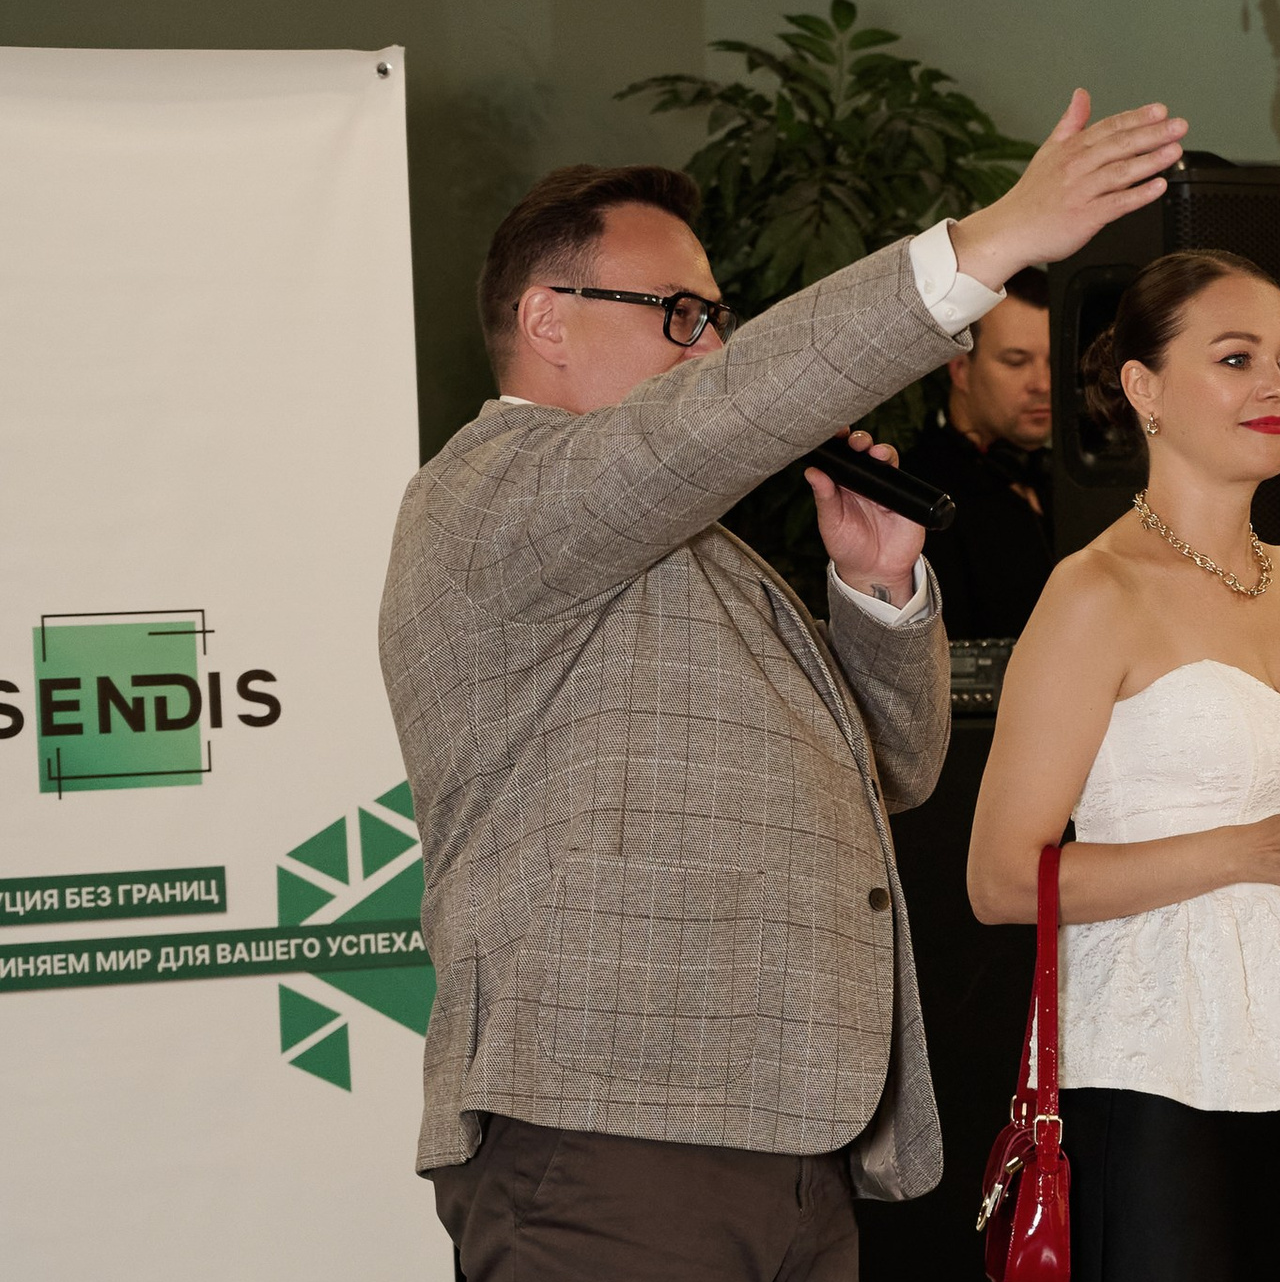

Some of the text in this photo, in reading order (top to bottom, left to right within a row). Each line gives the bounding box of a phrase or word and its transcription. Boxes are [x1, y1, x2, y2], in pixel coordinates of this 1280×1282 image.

[0, 879, 219, 916] ЦИЯ БЕЗ ГРАНИЦ
[96, 948, 152, 972] МИР
[158, 945, 210, 973] ДЛЯ
[216, 937, 320, 964] ВАШЕГО
[326, 931, 426, 957] УСПЕХА
